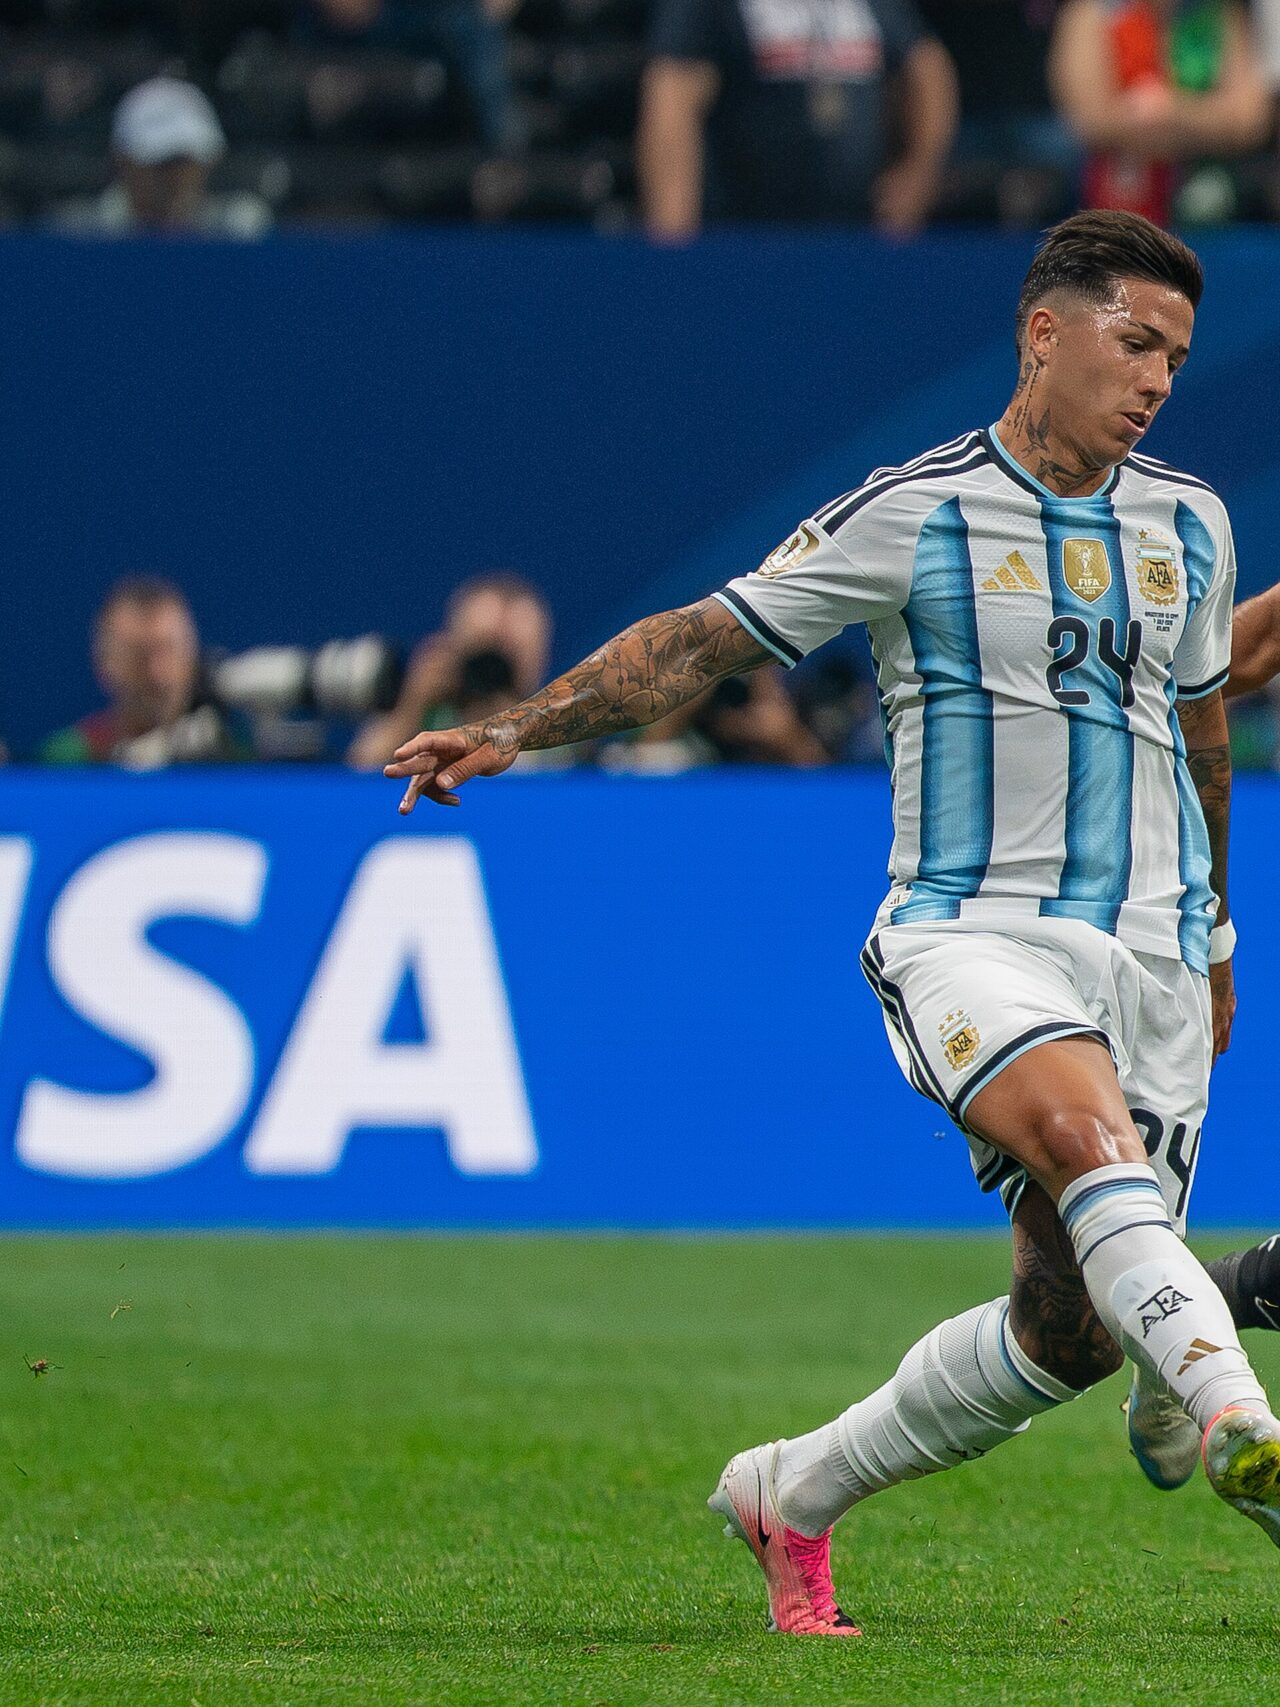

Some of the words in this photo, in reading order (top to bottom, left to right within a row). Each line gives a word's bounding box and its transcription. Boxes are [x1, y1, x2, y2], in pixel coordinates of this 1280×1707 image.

[1078, 578, 1100, 587] FIFA
[1146, 559, 1173, 590] AFA
[1047, 616, 1142, 708] 24
[950, 1031, 974, 1058] AFA
[1136, 1284, 1194, 1339] AFA
